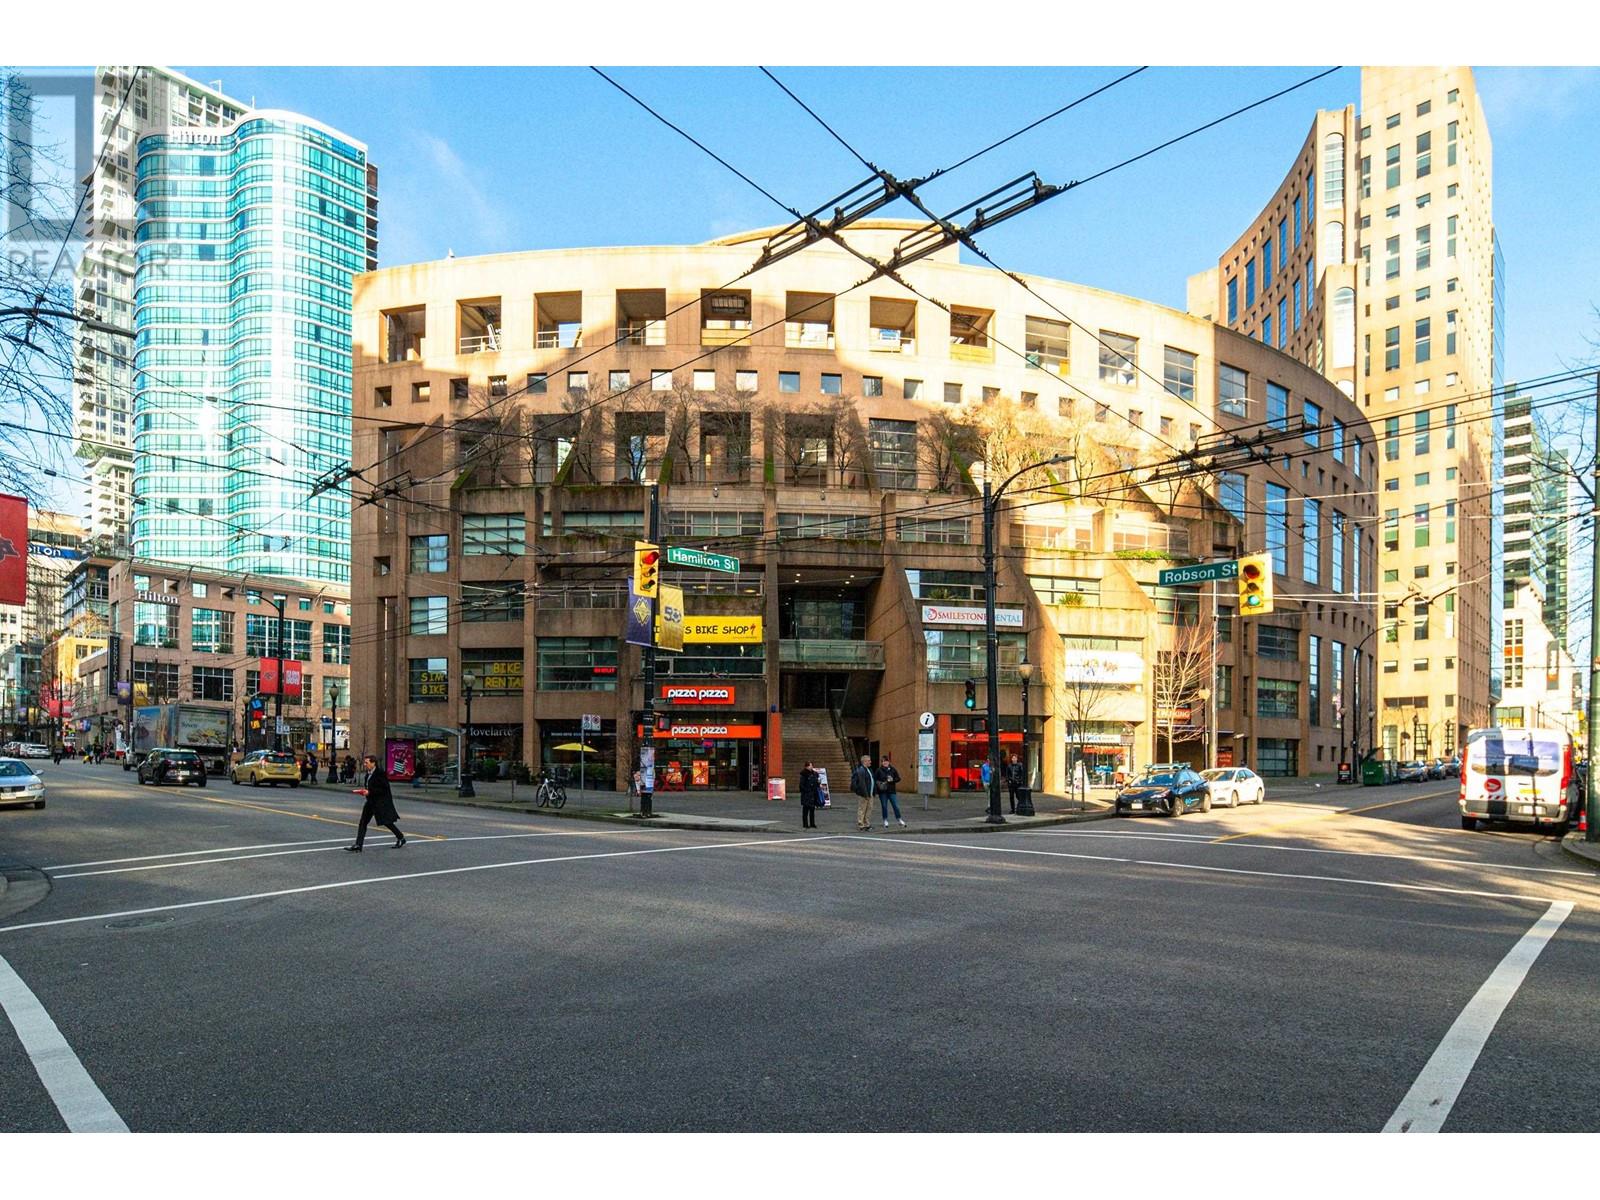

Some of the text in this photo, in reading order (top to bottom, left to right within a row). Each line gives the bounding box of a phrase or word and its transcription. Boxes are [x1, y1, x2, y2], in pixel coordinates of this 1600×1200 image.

[672, 550, 735, 570] Hamilton St
[1165, 564, 1237, 583] Robson St
[137, 590, 178, 604] Hilton
[996, 613, 1021, 623] ENTAL
[695, 625, 718, 635] BIKE
[722, 625, 749, 635] SHOP
[493, 662, 521, 674] BIKE
[421, 684, 446, 695] BIKE
[667, 689, 728, 700] pizza pizza
[671, 726, 728, 736] pizza pizza
